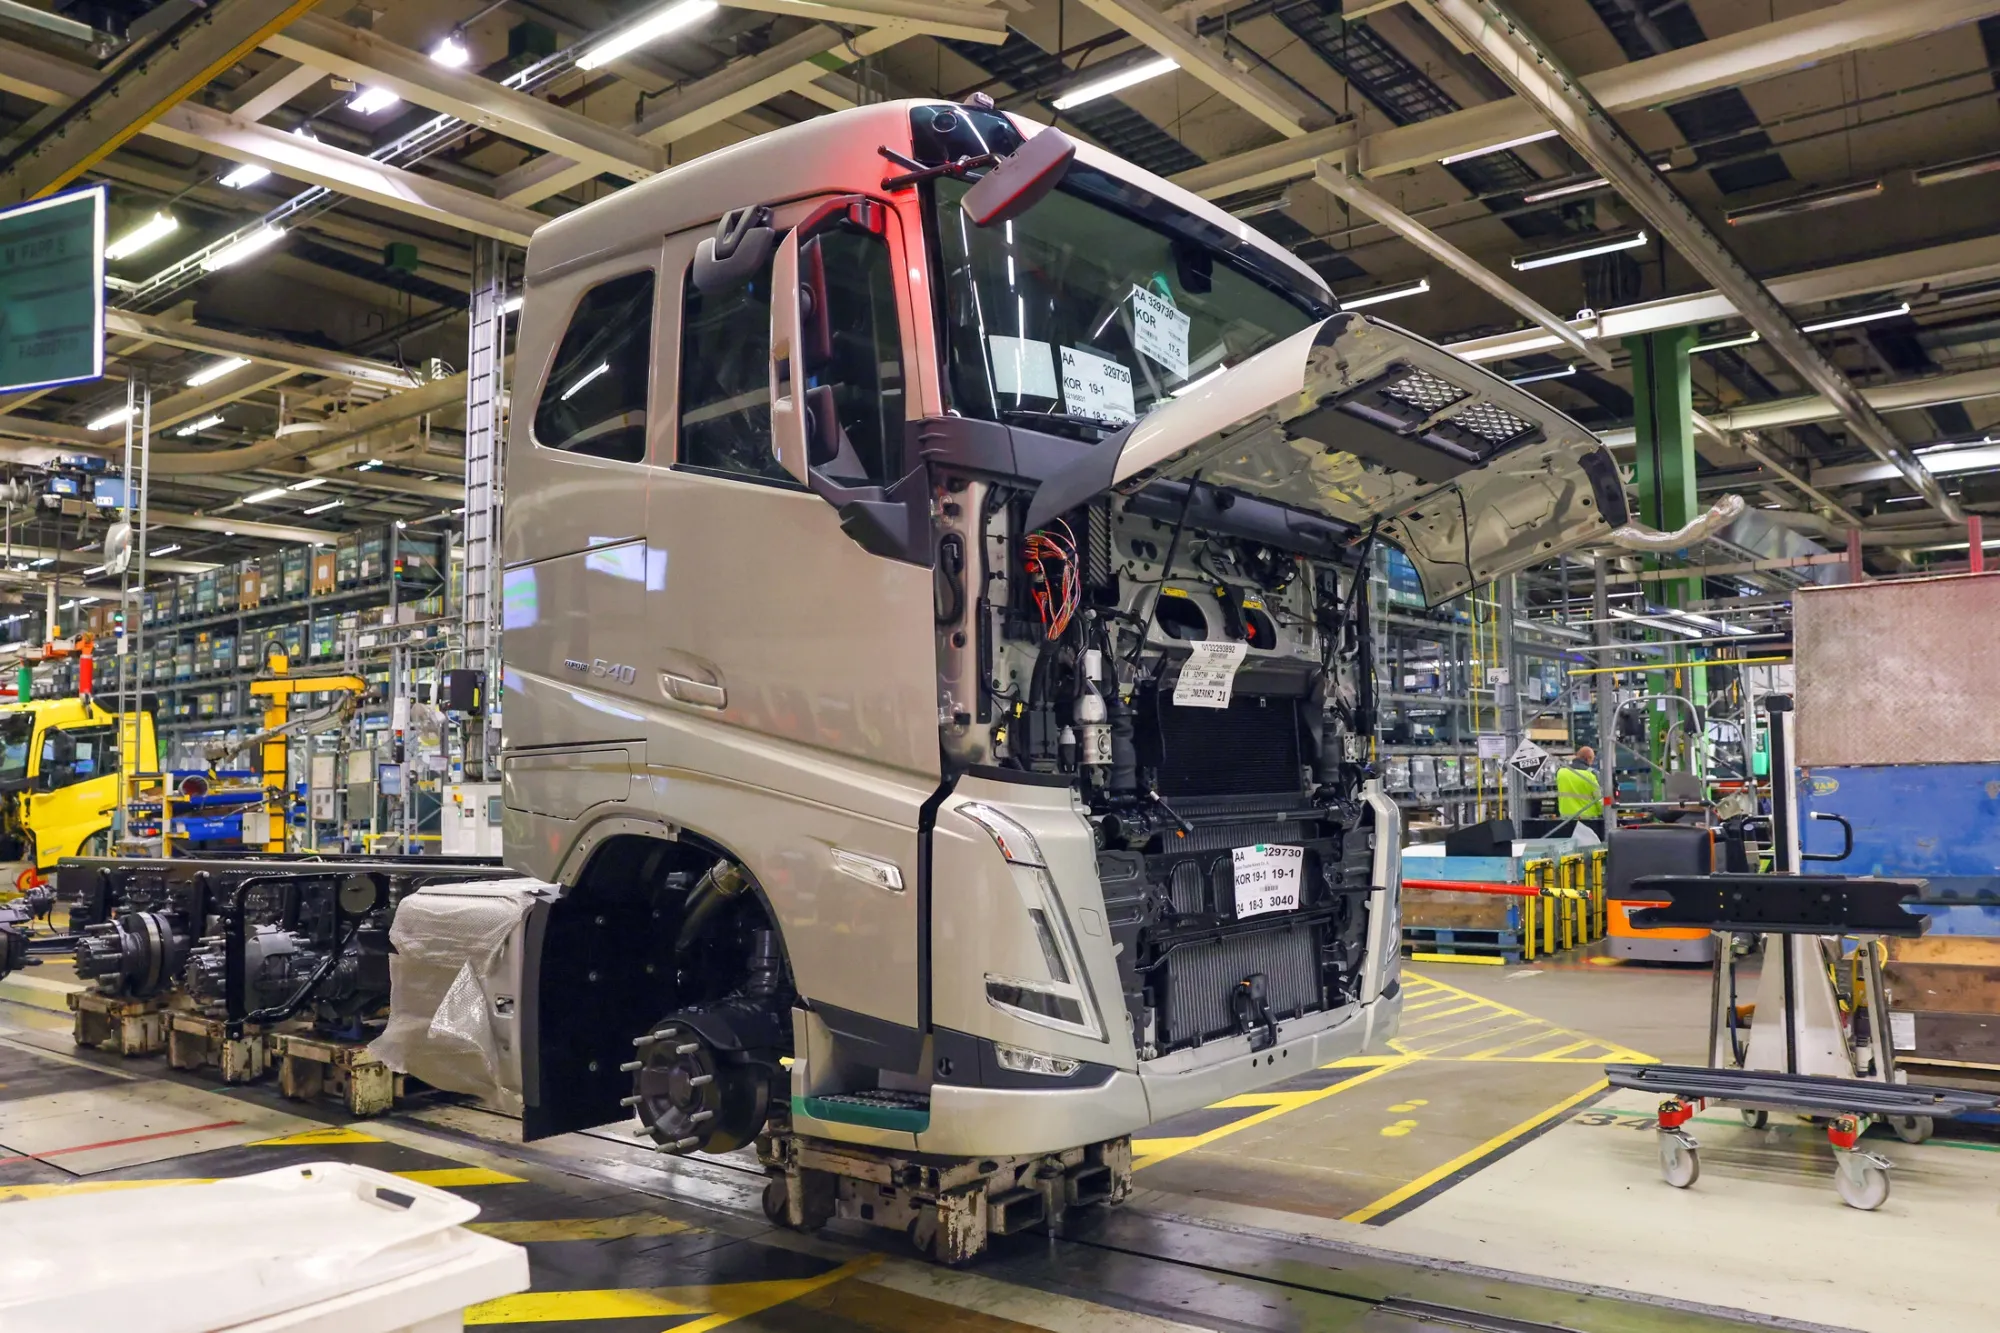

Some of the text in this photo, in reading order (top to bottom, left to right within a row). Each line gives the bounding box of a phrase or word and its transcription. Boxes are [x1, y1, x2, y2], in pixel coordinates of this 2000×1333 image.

[1134, 289, 1174, 320] AA 329730
[1135, 306, 1157, 328] KOR
[1062, 352, 1076, 366] AA
[1168, 343, 1181, 357] 17-5
[1103, 364, 1131, 384] 329730
[1063, 376, 1104, 396] KOR 19-1
[592, 658, 636, 686] 540
[1217, 690, 1227, 702] 21
[1235, 847, 1302, 862] AA 329730
[1235, 868, 1294, 886] KOR 19-1 19-1
[1249, 898, 1264, 911] 18-3
[1270, 895, 1294, 907] 3040
